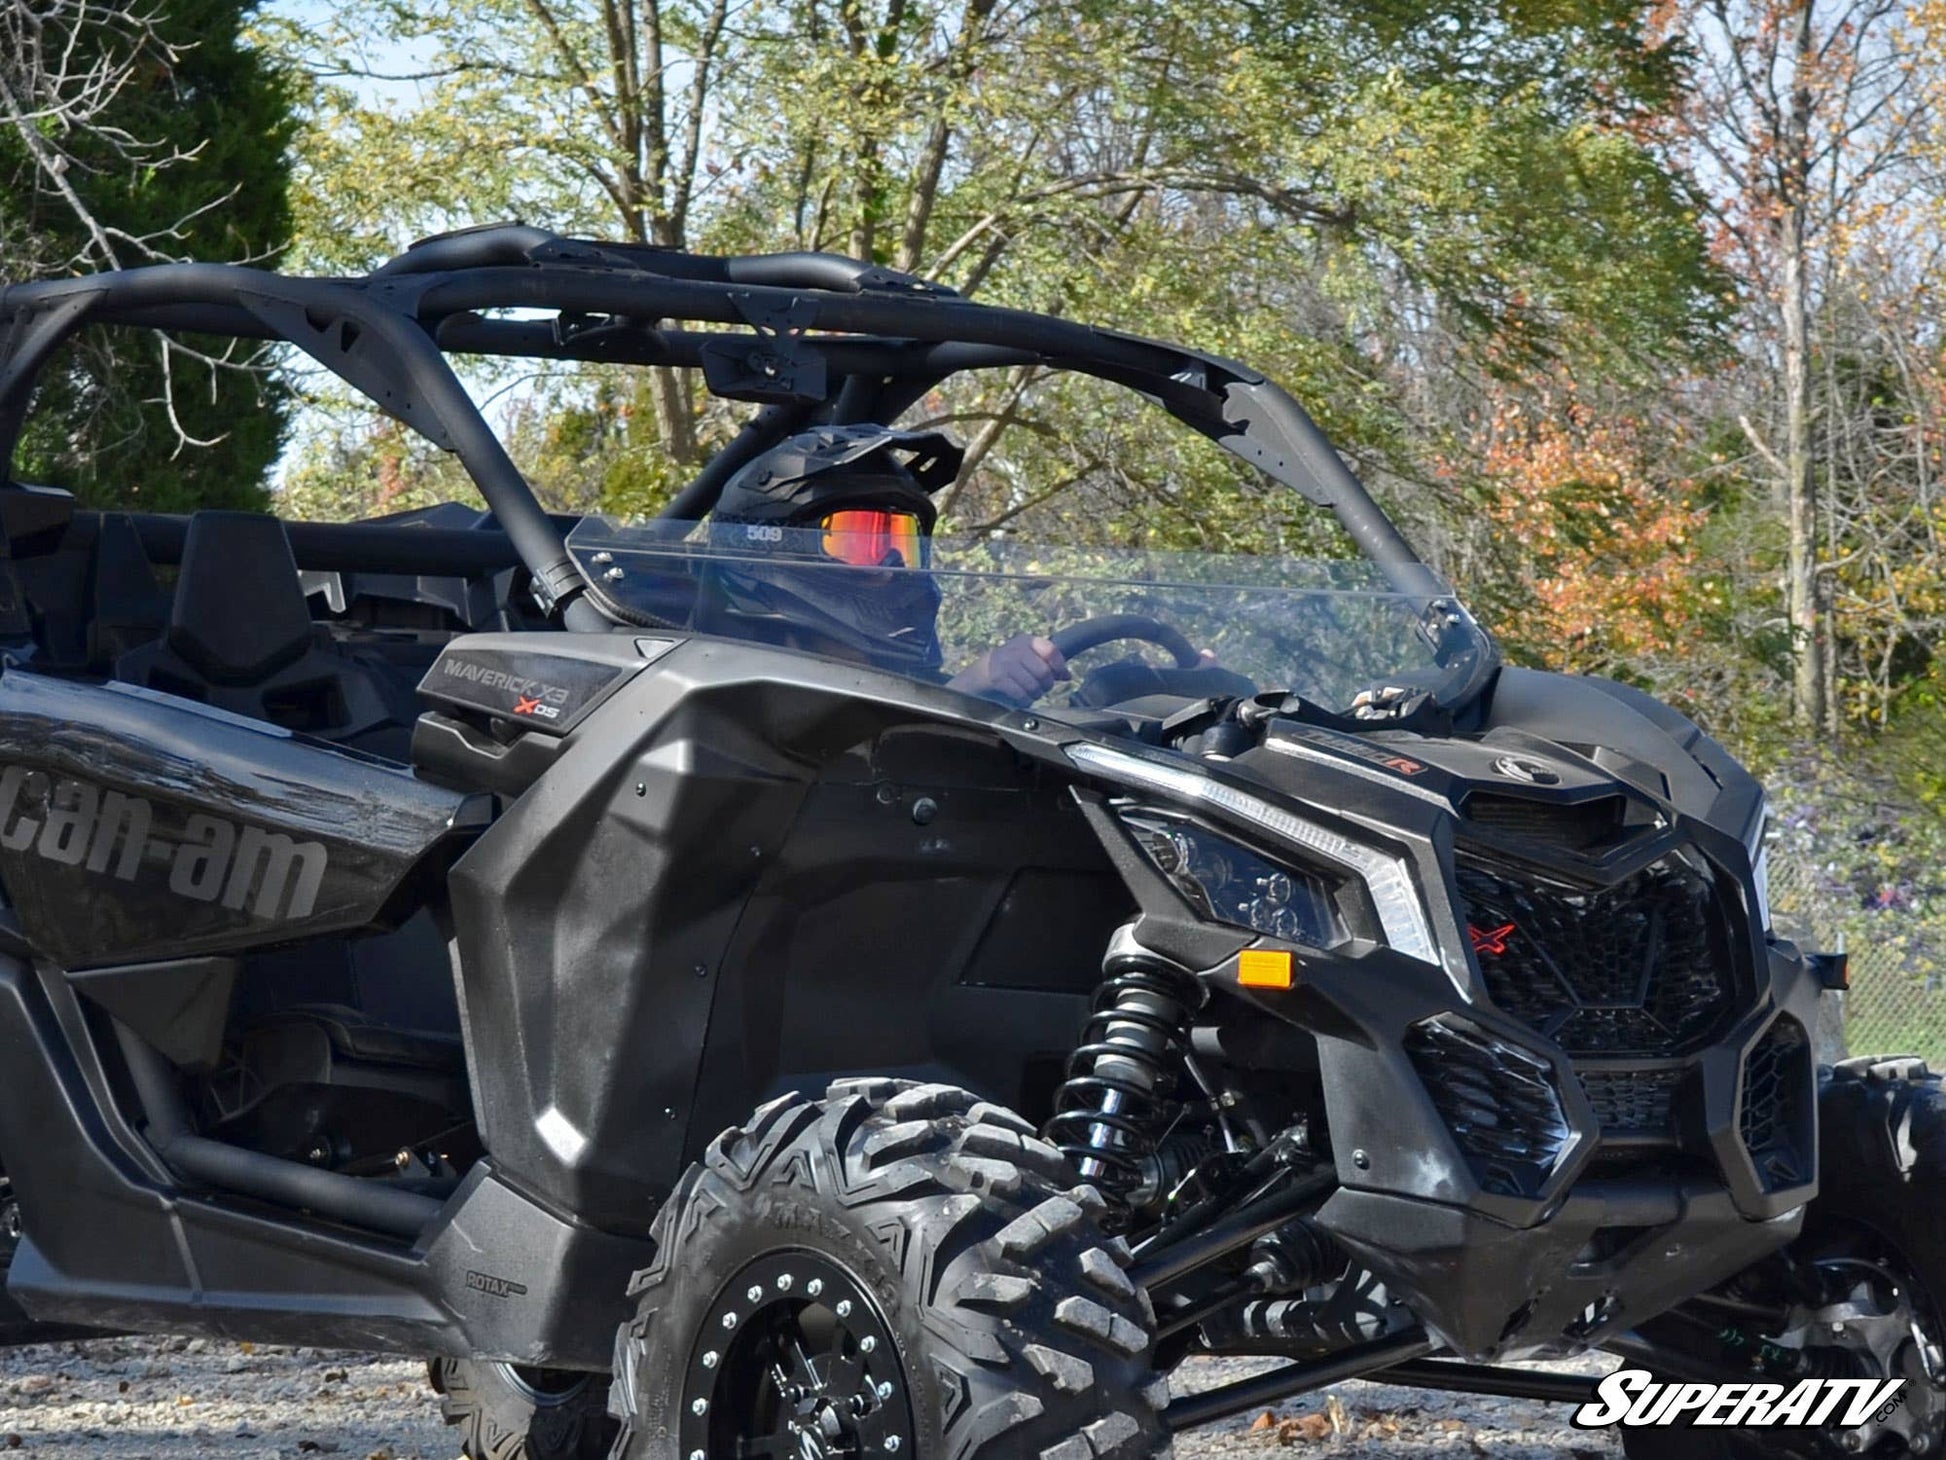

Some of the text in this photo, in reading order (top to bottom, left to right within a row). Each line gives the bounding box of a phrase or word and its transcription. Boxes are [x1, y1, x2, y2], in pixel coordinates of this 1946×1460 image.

[748, 526, 782, 541] 509
[445, 658, 569, 704] MAVERICK X3
[467, 1271, 509, 1296] ROTAX
